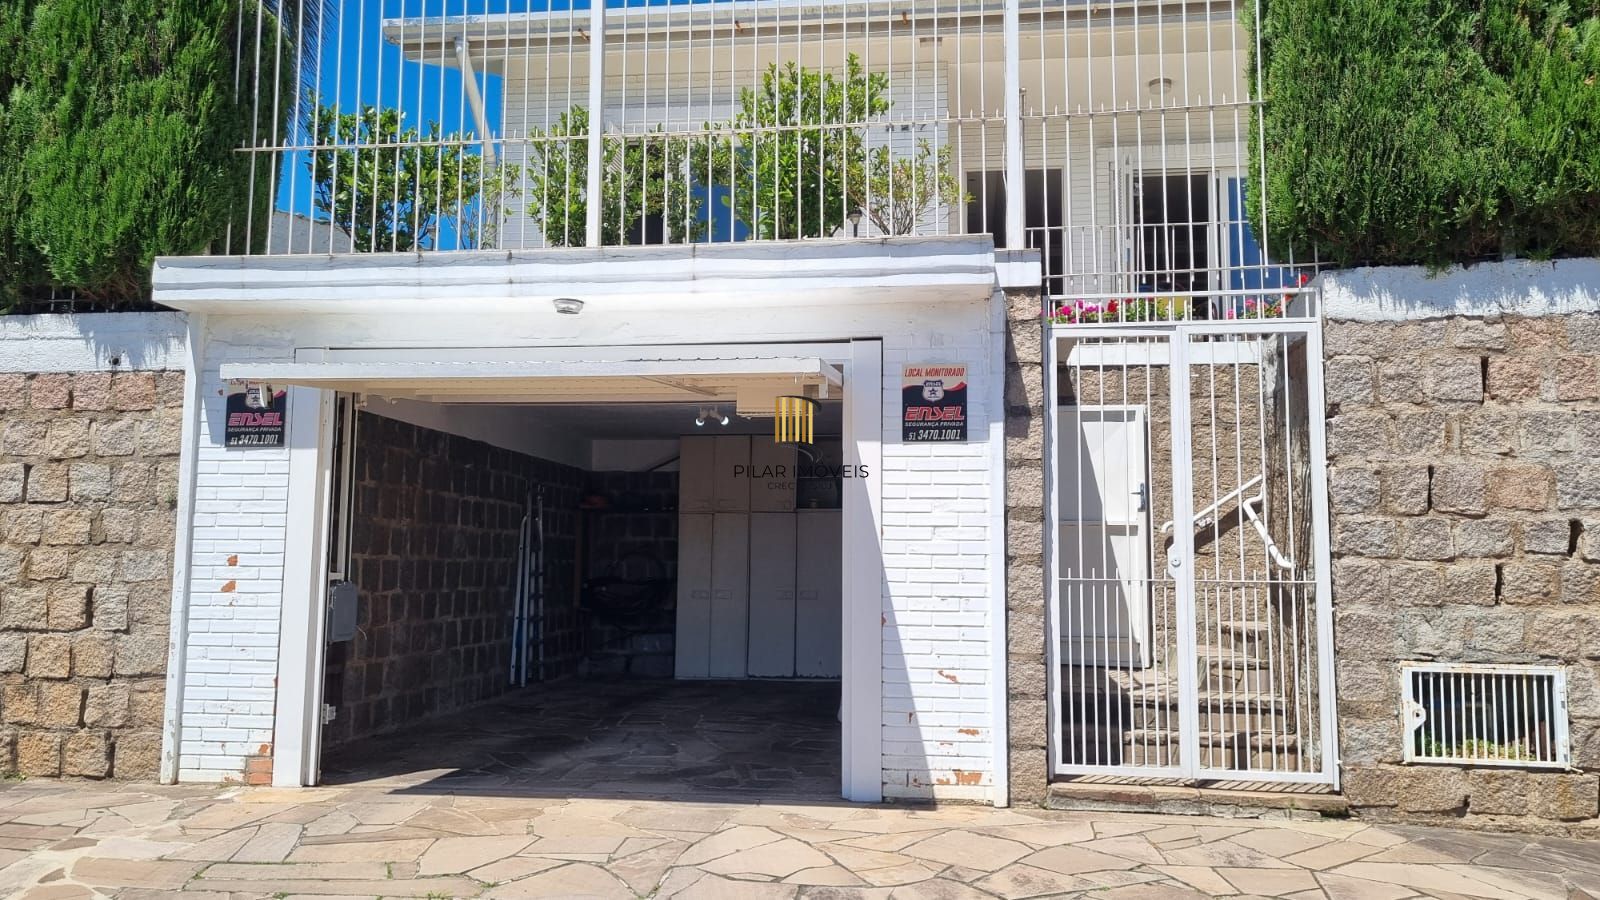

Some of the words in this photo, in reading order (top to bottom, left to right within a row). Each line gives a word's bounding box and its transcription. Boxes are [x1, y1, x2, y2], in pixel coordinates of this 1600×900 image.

[905, 368, 922, 377] LOCAL
[924, 367, 965, 377] MONITORADO
[228, 412, 283, 426] ENSEL
[905, 406, 965, 421] ENSEL
[239, 434, 279, 445] 3470.1001
[909, 432, 916, 441] 51
[918, 429, 961, 440] 3470.1001
